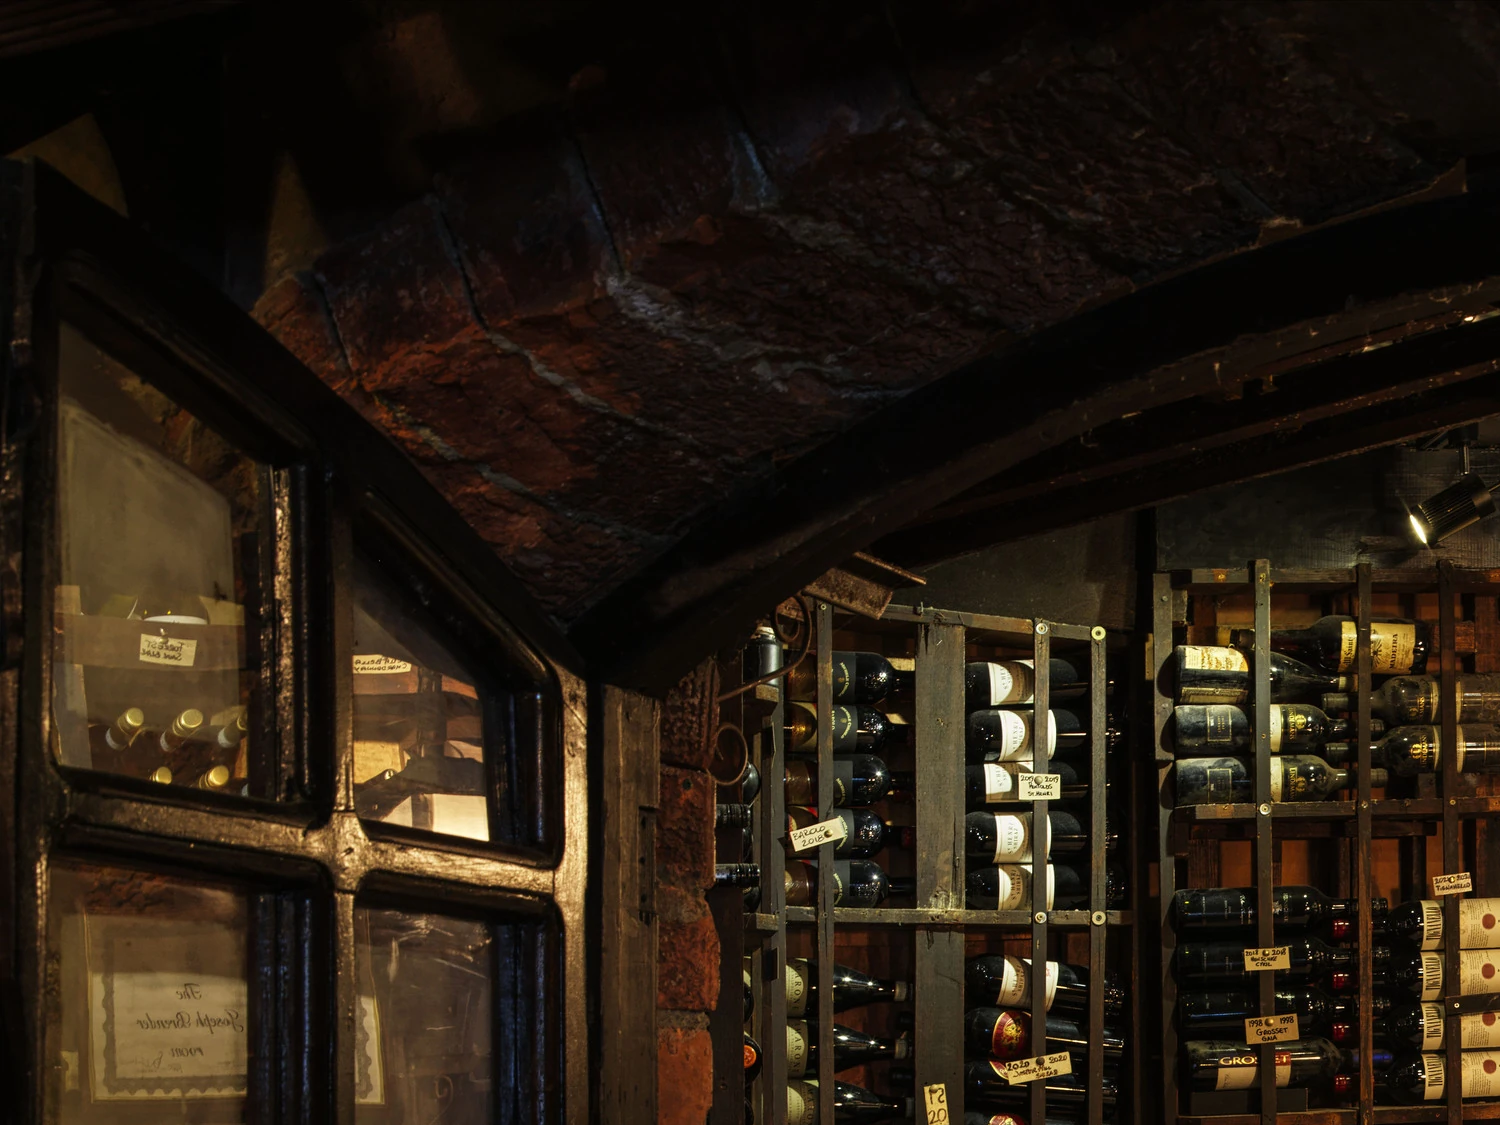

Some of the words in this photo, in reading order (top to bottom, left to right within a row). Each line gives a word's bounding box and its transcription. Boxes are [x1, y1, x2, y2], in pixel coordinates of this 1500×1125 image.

[1389, 634, 1398, 669] MADEIRA
[793, 826, 825, 841] BAROLO
[803, 835, 824, 847] 2018
[1426, 906, 1442, 941] TIGNANELLO
[1425, 956, 1441, 991] TIGNANELLO
[1248, 1019, 1264, 1028] 1998
[1279, 1016, 1295, 1024] 1998
[1426, 1005, 1442, 1039] TIGNANELLO
[1255, 1027, 1288, 1036] GROSSET
[1007, 1060, 1029, 1071] 2020
[1049, 1055, 1068, 1064] 2020
[1427, 1055, 1443, 1088] TIGNANELLO
[928, 1108, 946, 1125] 20
